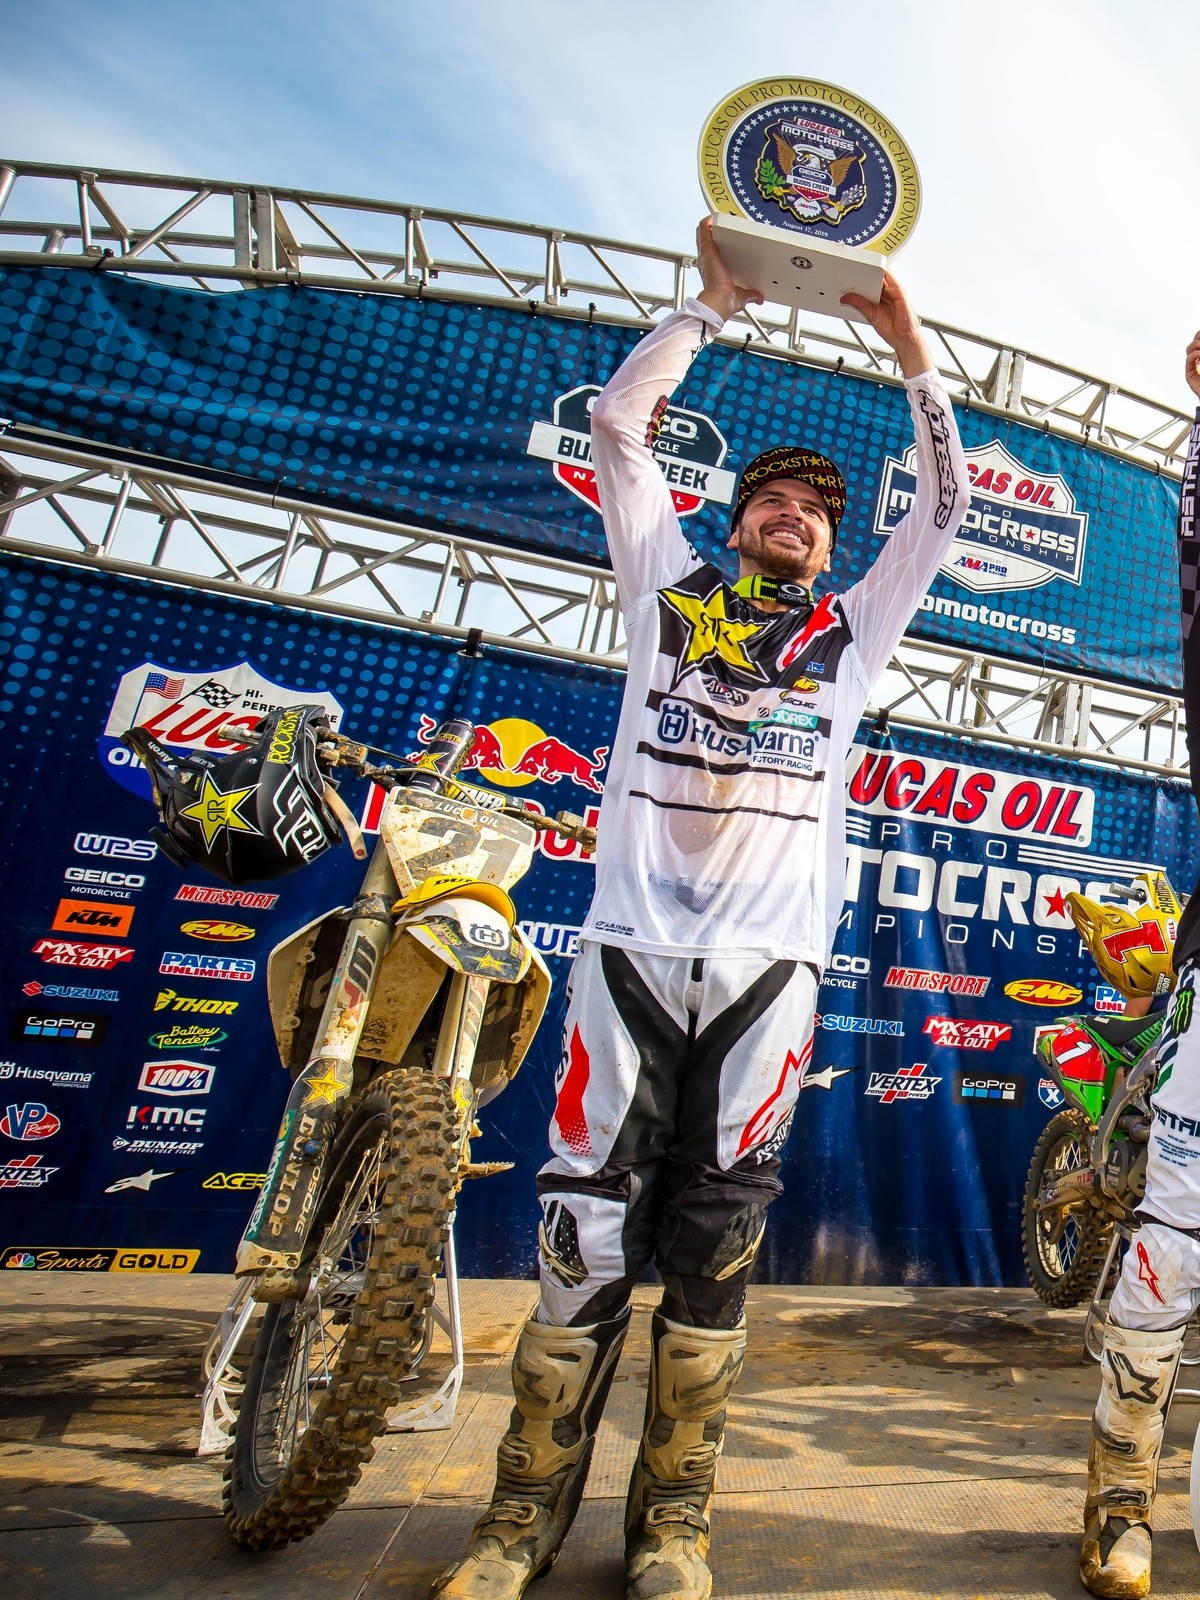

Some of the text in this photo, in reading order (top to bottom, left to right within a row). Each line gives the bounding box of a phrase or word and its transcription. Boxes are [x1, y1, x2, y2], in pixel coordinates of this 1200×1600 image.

[781, 124, 855, 151] MOTOCROSS
[799, 119, 841, 137] LUCAS OIL
[706, 83, 917, 252] 2019 LUCAS OIL PRO MOTOCROSS CHAMPIONSHIP
[798, 167, 827, 180] GEICO
[782, 220, 803, 231] August
[967, 463, 1055, 509] CAS OIL
[953, 555, 989, 573] AMA
[989, 564, 1008, 574] PRO
[245, 688, 264, 700] HI-
[1001, 781, 1083, 839] OIL
[74, 832, 158, 862] WPS
[880, 822, 1008, 859] PRO
[405, 815, 521, 892] 21
[64, 867, 145, 889] GEICO
[70, 885, 132, 899] MOTORCYCLE
[64, 909, 123, 928] KTM
[180, 922, 256, 938] FMF
[1167, 921, 1178, 941] BELL
[33, 940, 79, 956] MX
[89, 945, 135, 961] ATV
[46, 954, 113, 969] ALL OUT
[160, 951, 256, 973] PARTS
[159, 965, 253, 982] UNLIMITED
[43, 984, 119, 1002] SUZUKI
[1004, 982, 1083, 1003] FMF
[172, 996, 240, 1016] THOR
[26, 1016, 96, 1030] GoPro
[821, 1013, 904, 1036] SUZUKI
[925, 1017, 961, 1036] MX
[970, 1023, 1012, 1040] ATV
[156, 1034, 210, 1050] Tender
[171, 1025, 221, 1041] Battery
[936, 1034, 993, 1049] ALL OUT
[1056, 1041, 1093, 1065] 1
[15, 1066, 93, 1083] Husqvarna
[150, 1068, 203, 1089] 100%
[868, 1073, 943, 1092] VERTEX
[962, 1077, 1016, 1091] GoPro
[1047, 1088, 1061, 1104] X
[7, 1102, 47, 1140] VP
[127, 1105, 207, 1126] KMC
[26, 1120, 59, 1136] Racing
[126, 1124, 202, 1133] WHEELS
[126, 1139, 205, 1151] DUNLOP
[126, 1147, 174, 1155] MOTORCYCLE
[246, 1141, 284, 1236] MOTOREX
[37, 1250, 189, 1270] Sports GOLD
